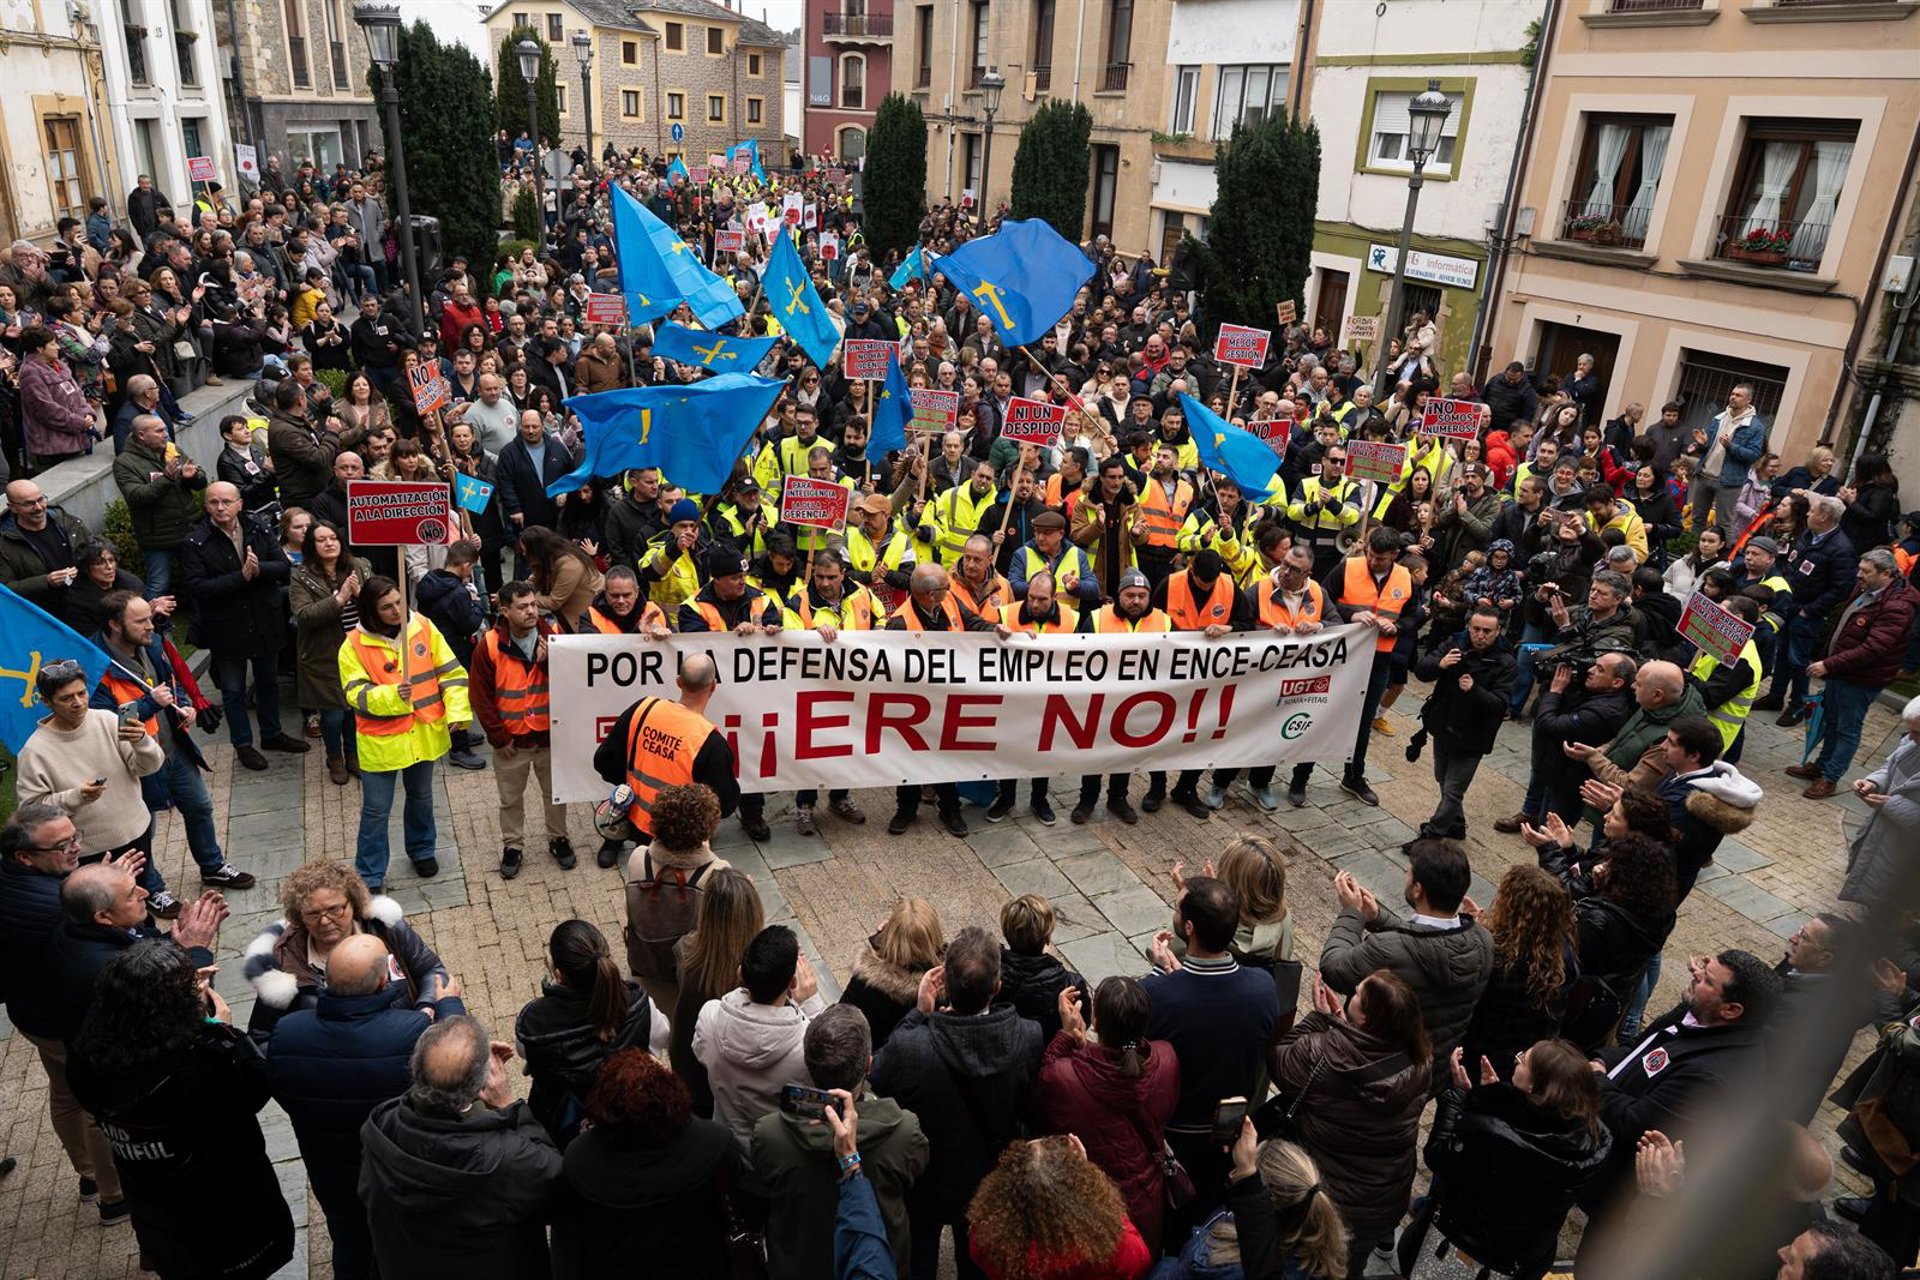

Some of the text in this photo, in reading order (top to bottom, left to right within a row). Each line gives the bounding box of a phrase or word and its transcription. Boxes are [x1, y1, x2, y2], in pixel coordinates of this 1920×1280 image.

[811, 94, 830, 102] N&G
[1427, 258, 1474, 276] Informática
[1576, 314, 1582, 324] 7
[848, 343, 860, 351] SIN
[1229, 338, 1257, 348] MEJOR
[857, 352, 886, 361] NO HAY
[410, 365, 430, 387] NO
[1015, 406, 1052, 420] NI UN
[1438, 413, 1473, 423] SOMOS
[1005, 421, 1061, 435] DESPIDO
[1253, 423, 1270, 440] NO
[792, 481, 812, 489] PARA
[349, 487, 449, 508] AUTOMATIZACIÓN
[786, 489, 836, 498] INTELIGENCIA
[355, 501, 445, 522] A LA DIRECCIÓN
[784, 510, 828, 519] GERENCIA
[1719, 614, 1752, 639] ARREGLA
[586, 651, 664, 687] POR
[733, 646, 893, 683] DEFENSA
[904, 648, 967, 684] DEL
[978, 647, 1109, 683] EMPLEO
[1118, 649, 1160, 681] EN
[1169, 637, 1348, 681] ENCE-CEASA
[1283, 680, 1316, 696] UGT
[1037, 683, 1238, 752] NO!!
[642, 726, 683, 751] COMITÉ
[642, 738, 675, 762] CEASA
